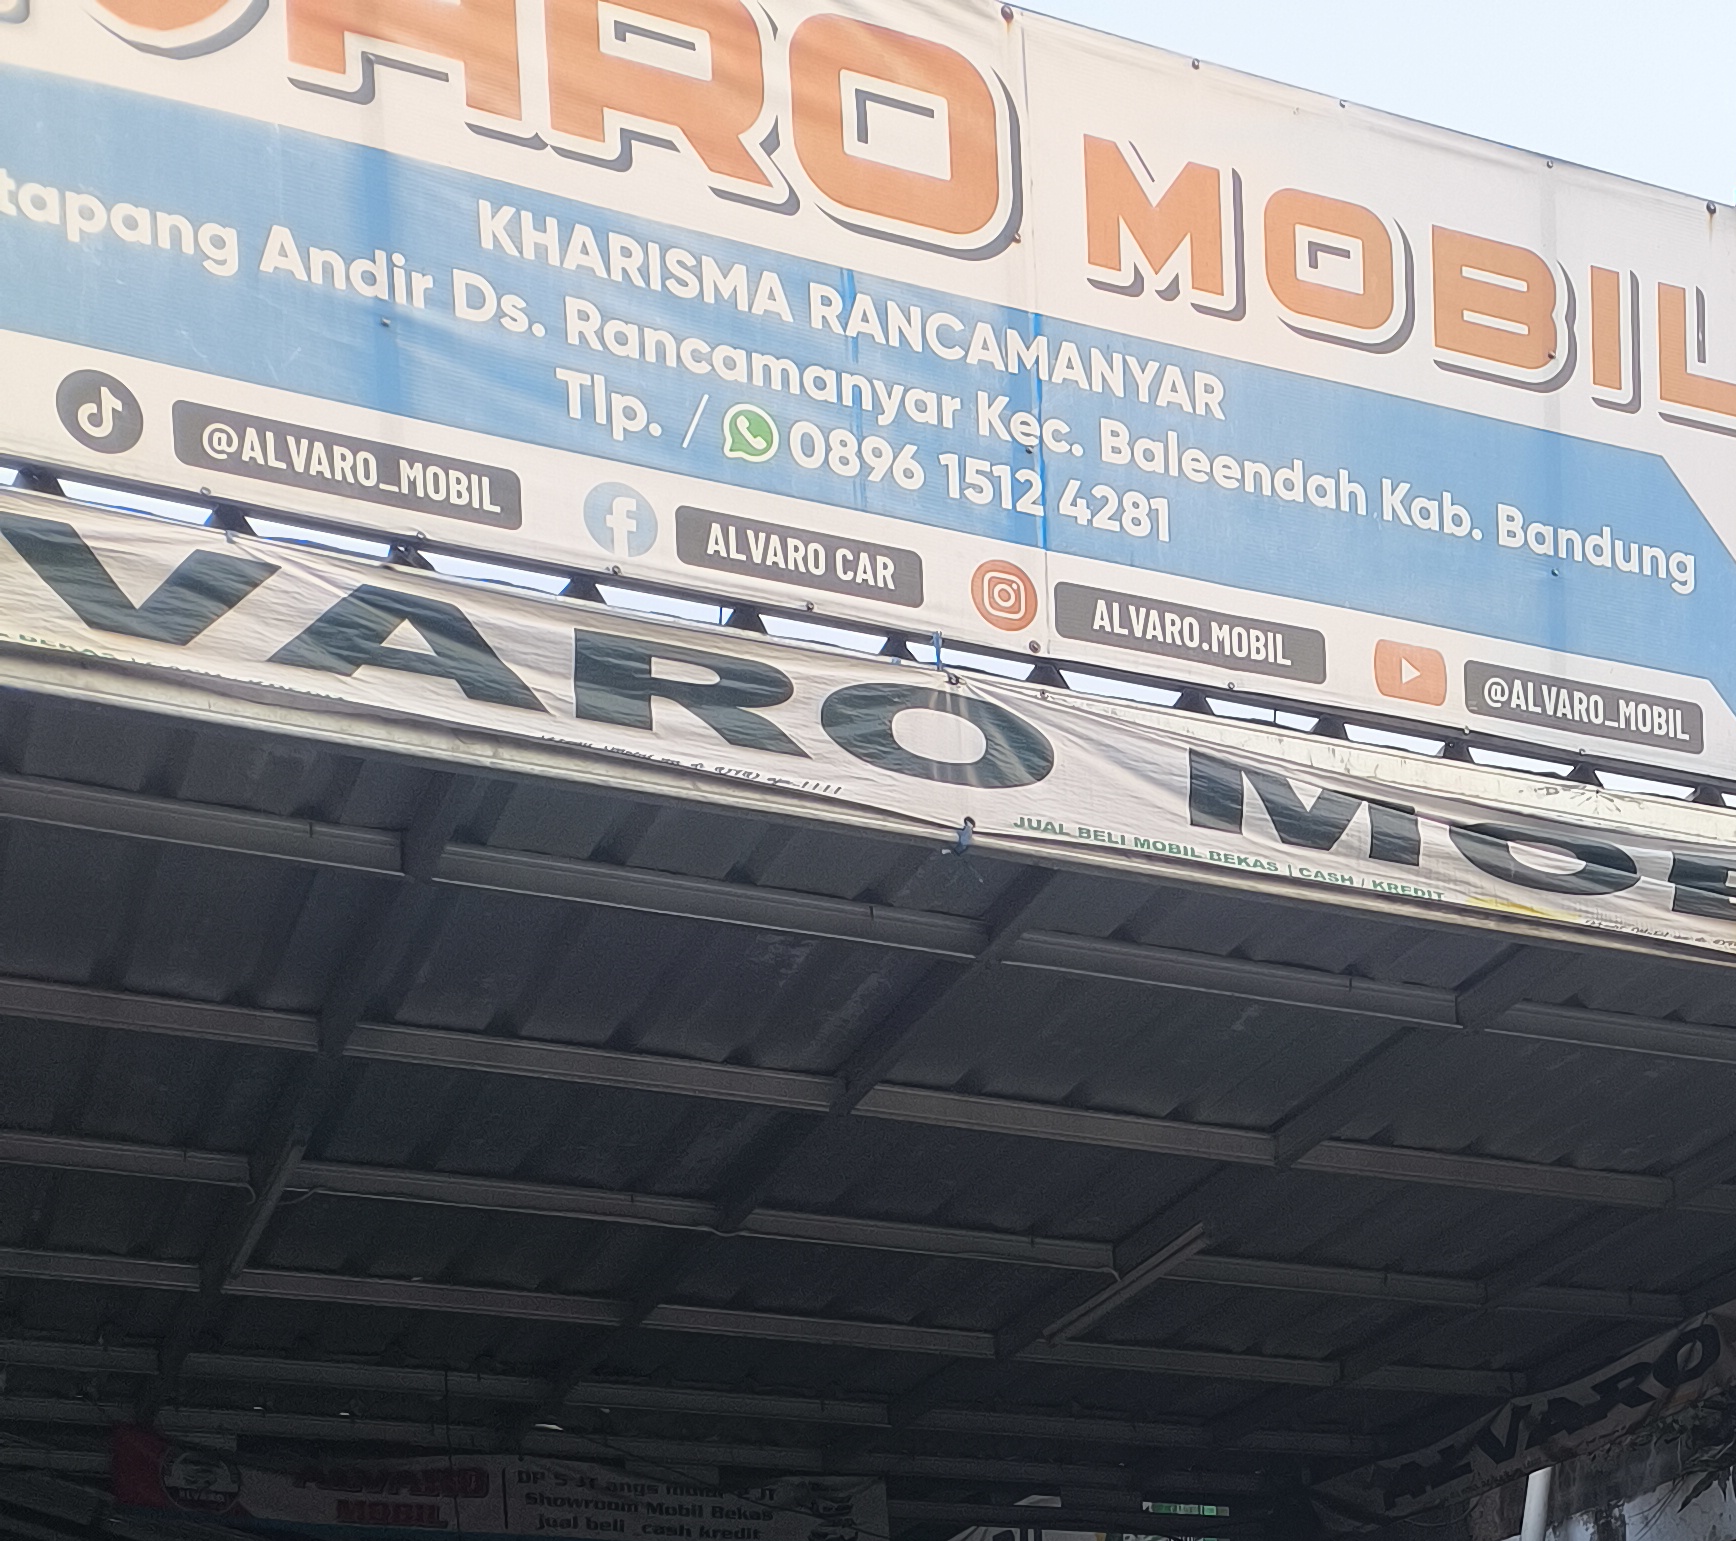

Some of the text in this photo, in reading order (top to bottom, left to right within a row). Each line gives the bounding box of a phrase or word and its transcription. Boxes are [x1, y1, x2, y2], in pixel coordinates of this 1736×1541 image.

[478, 199, 1226, 421] KHARISMA RANCAMANYAR
[260, 226, 432, 309] Andir
[453, 269, 546, 339] Ds.
[565, 297, 961, 430] Rancamanyar
[978, 386, 1083, 458] Kec.
[1101, 418, 1366, 517] Baleendah
[1382, 480, 1483, 542] Kab.
[1496, 502, 1696, 595] Bandung
[201, 420, 502, 516] @ALVARO_MOBIL
[556, 367, 663, 440] Tlp.
[789, 420, 925, 491] 0896
[938, 453, 1046, 518] 1512
[1058, 480, 1171, 543] 4281
[706, 522, 895, 590] ALVARO CAR
[0, 512, 1055, 790] VARO
[1092, 598, 1292, 667] ALVARO.MOBIL
[1483, 676, 1691, 742] @ALVARO_MOBIL
[1013, 815, 1067, 835] JUAL
[1077, 826, 1127, 846] BELI
[1133, 836, 1202, 860] MOBIL
[1208, 850, 1279, 874] BEKAS
[1298, 866, 1355, 887] CASH
[1370, 878, 1445, 902] KREDIT
[525, 1491, 774, 1521] Showroom Mobil Bekas
[537, 1513, 761, 1541] jual beli cash kredit
